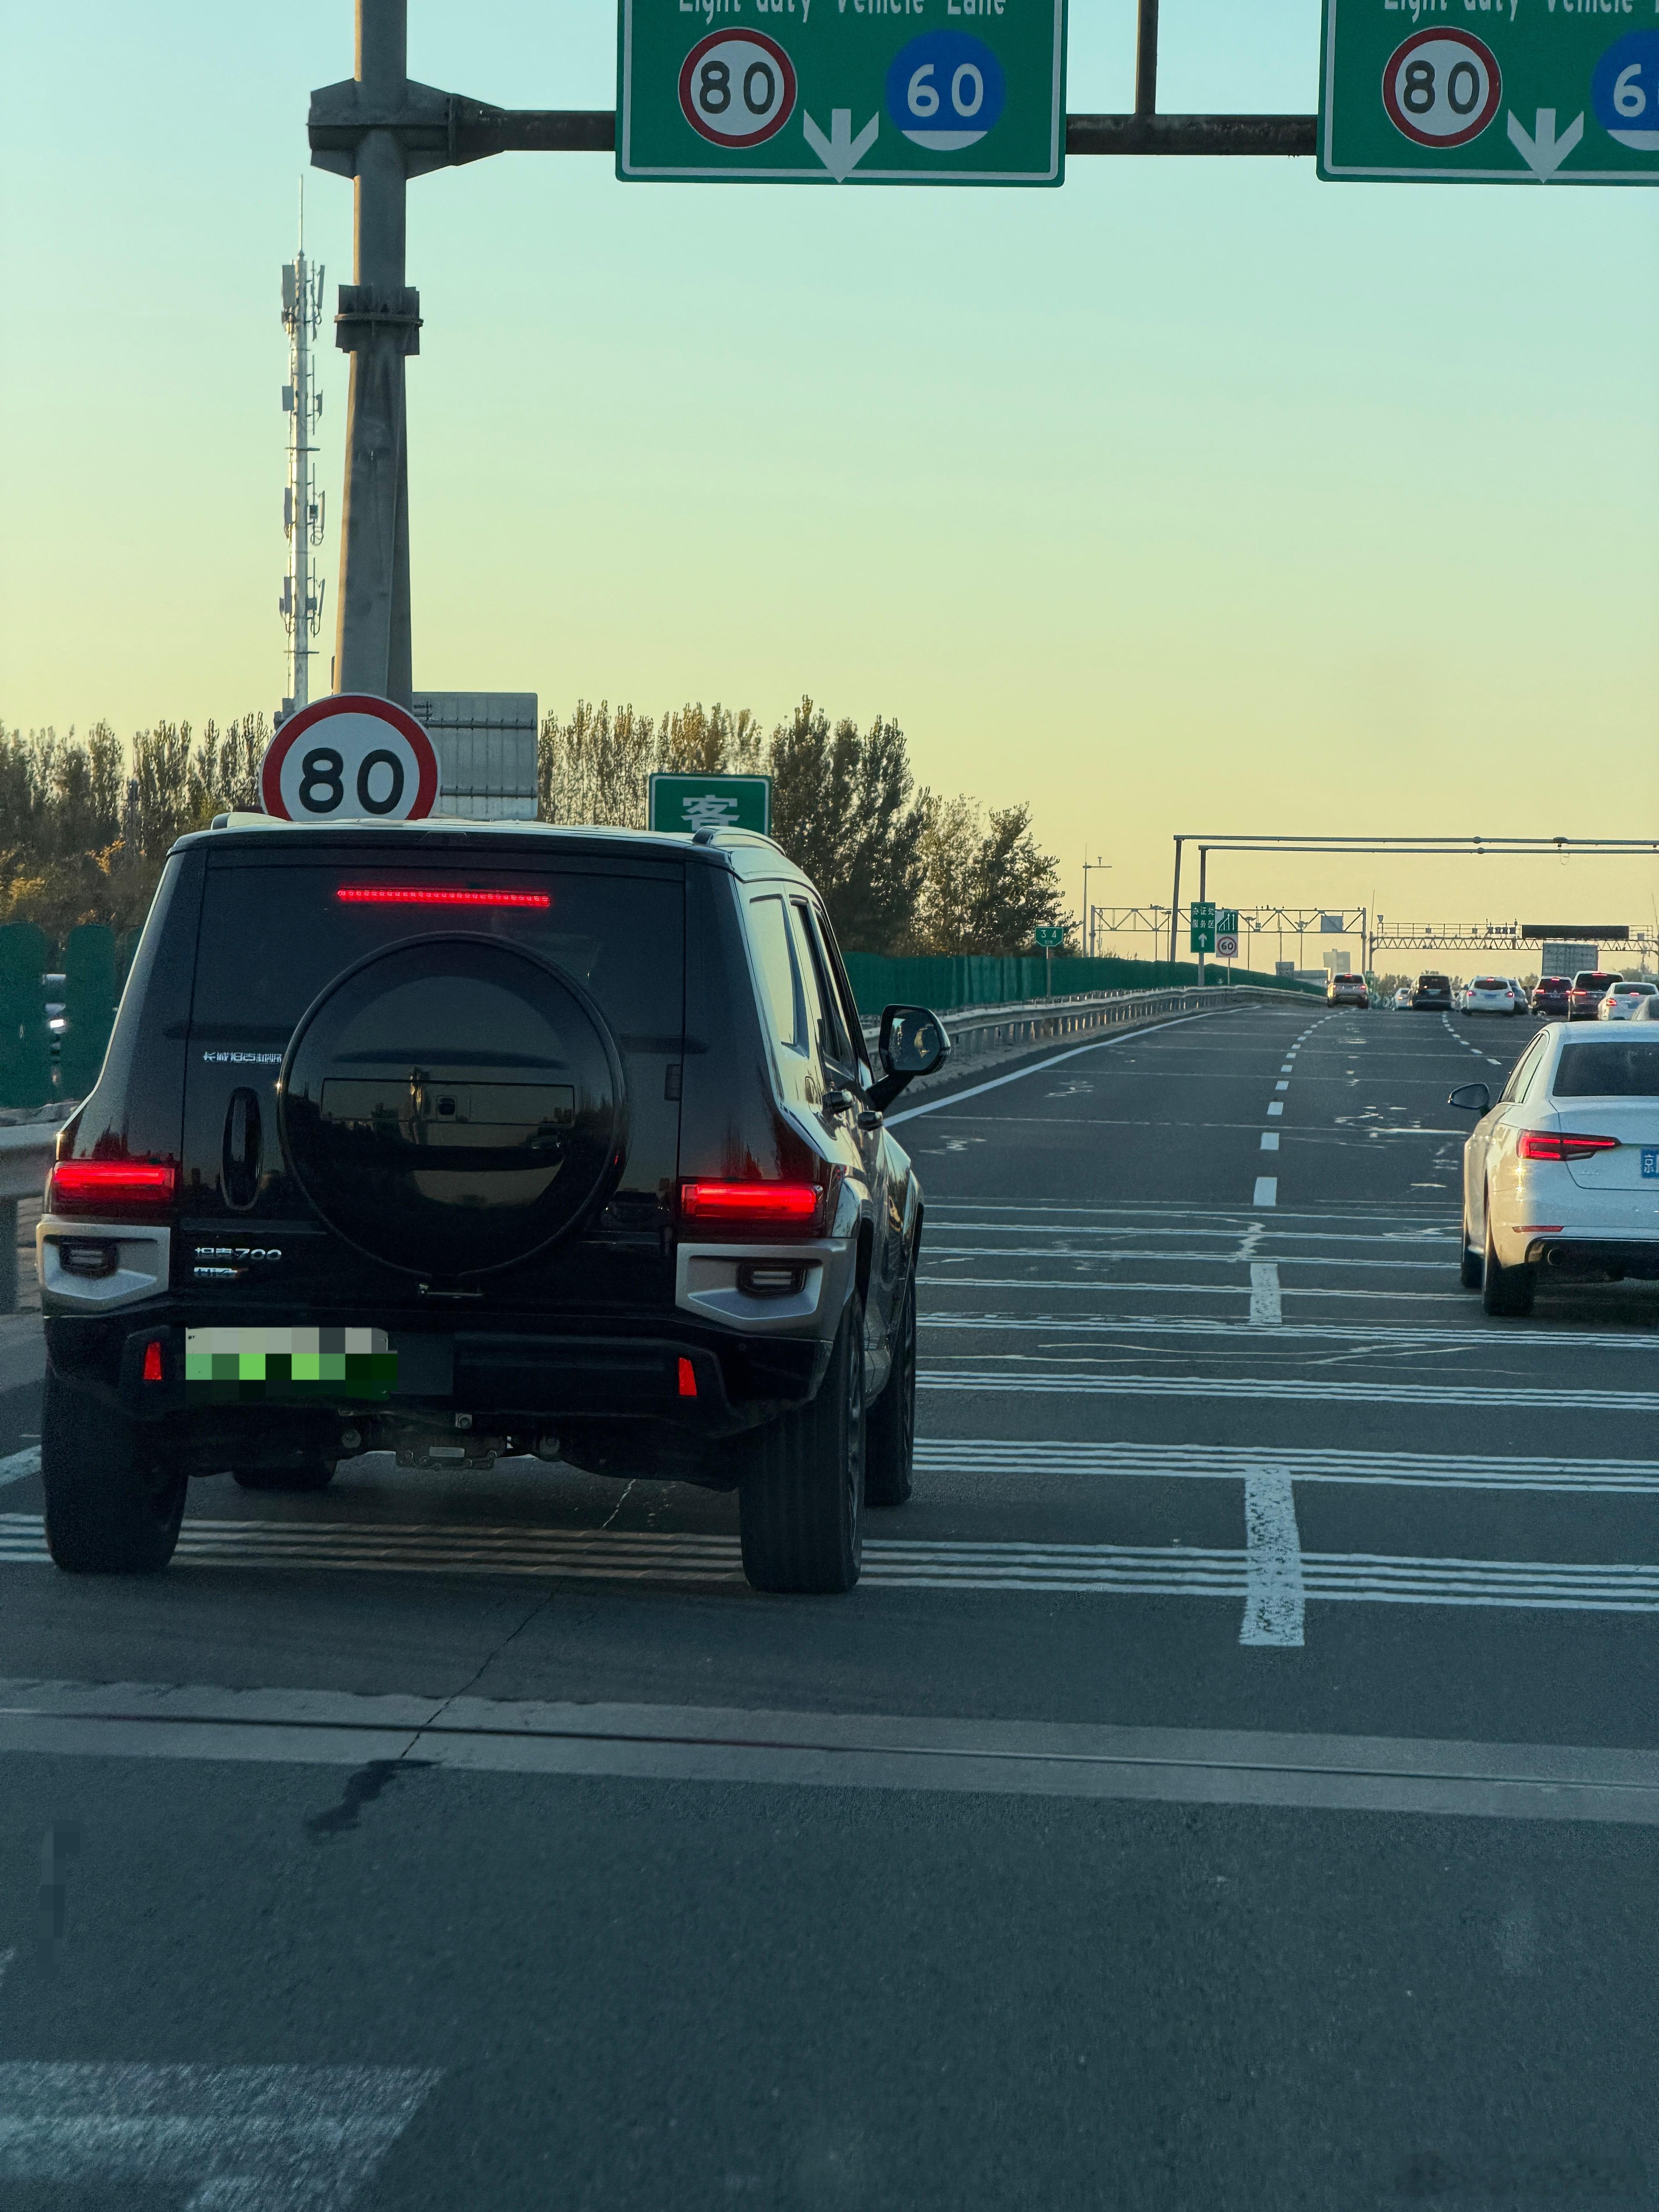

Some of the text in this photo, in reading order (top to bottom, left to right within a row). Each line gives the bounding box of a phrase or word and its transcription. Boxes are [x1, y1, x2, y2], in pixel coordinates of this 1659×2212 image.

[699, 60, 775, 115] 80
[907, 63, 984, 117] 60
[1403, 60, 1480, 115] 80
[1613, 64, 1659, 117] 6
[299, 747, 405, 814] 80
[681, 795, 740, 831] 客
[1192, 919, 1214, 928] 服务区
[1221, 942, 1234, 950] 60
